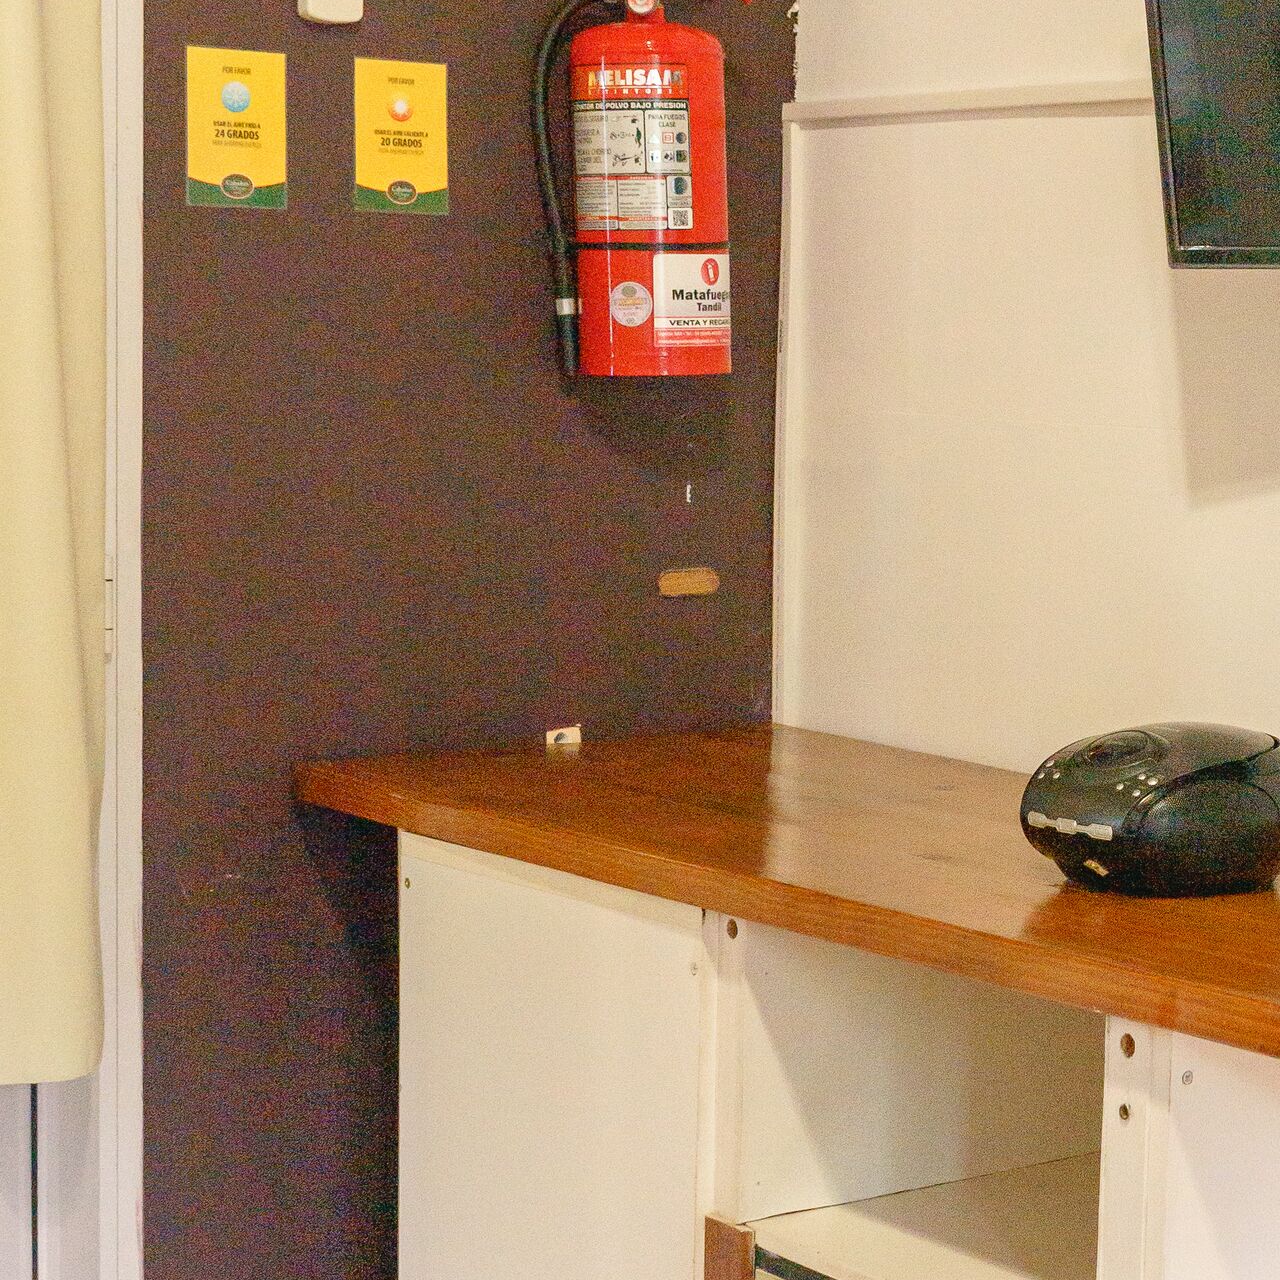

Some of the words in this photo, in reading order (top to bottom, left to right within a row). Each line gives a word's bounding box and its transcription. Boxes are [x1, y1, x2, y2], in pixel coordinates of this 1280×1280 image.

[606, 102, 629, 110] POLVO
[630, 102, 652, 110] BAJO
[214, 129, 225, 138] 24
[227, 129, 260, 140] GRADOS
[380, 137, 391, 146] 20
[392, 138, 423, 148] GRADOS
[696, 302, 722, 312] Tandil
